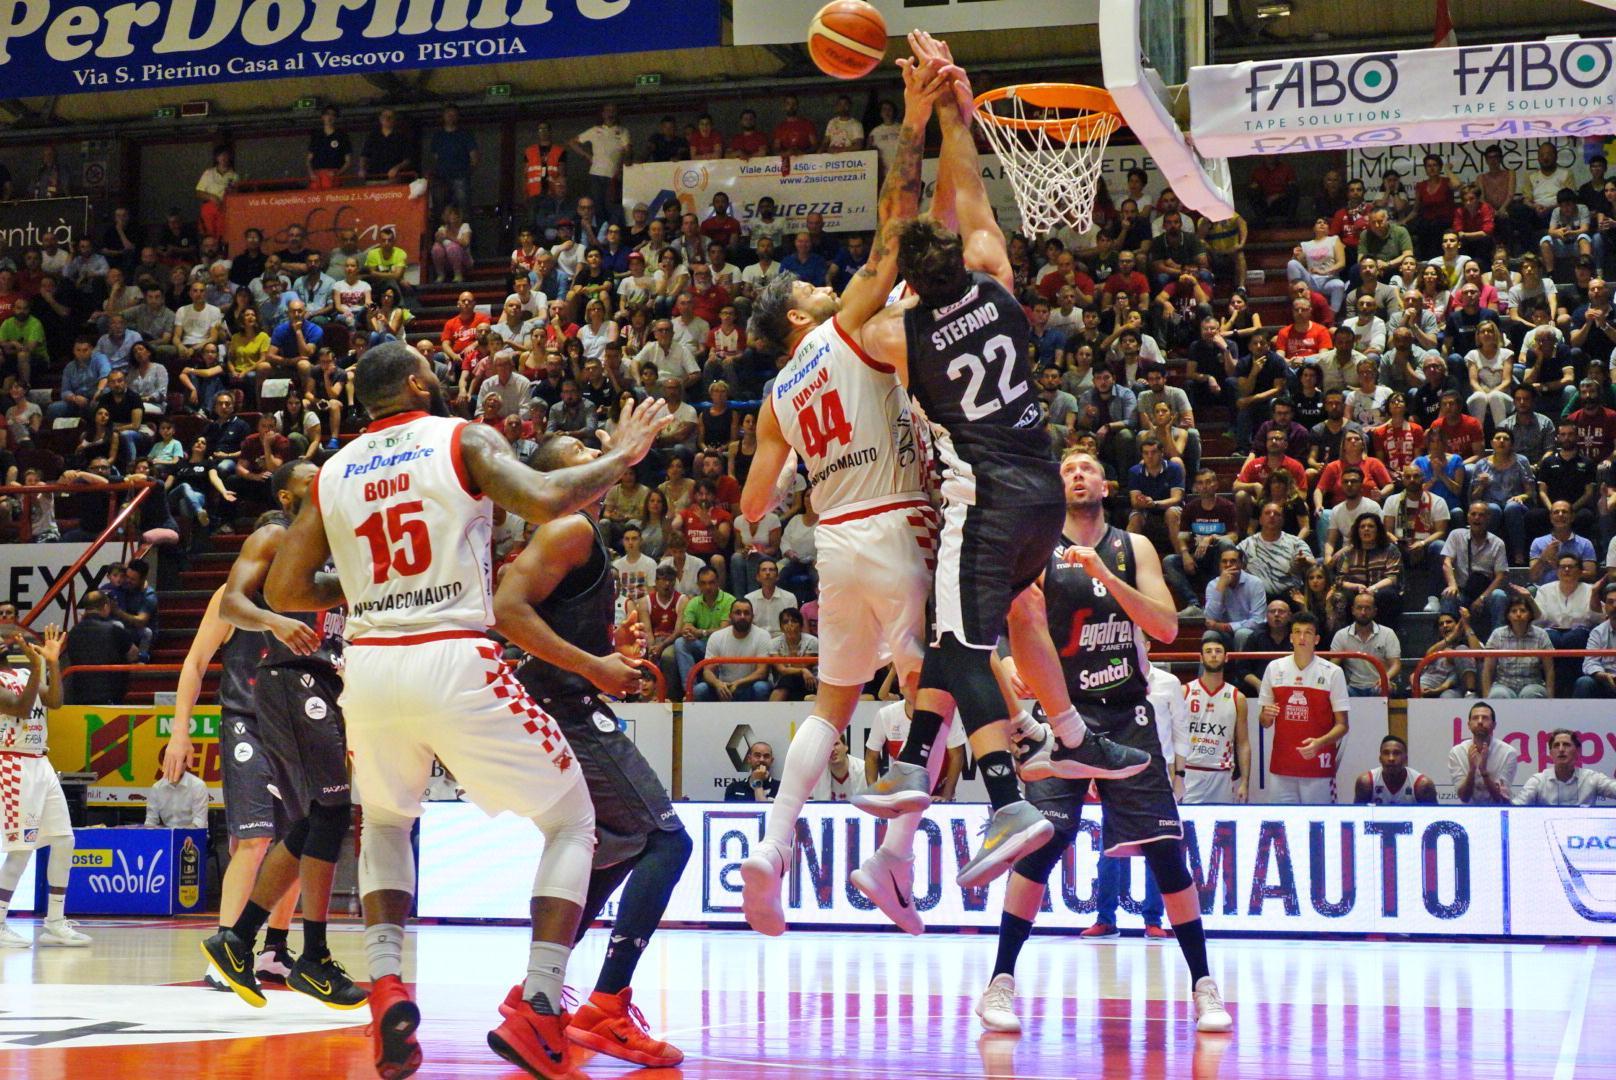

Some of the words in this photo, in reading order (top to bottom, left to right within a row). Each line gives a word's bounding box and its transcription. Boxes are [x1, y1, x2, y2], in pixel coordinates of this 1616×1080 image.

[73, 69, 108, 86] Via
[115, 66, 135, 83] S.
[141, 61, 220, 82] Pierino
[227, 56, 278, 75] Casa
[285, 52, 304, 71] al
[312, 50, 405, 68] Vescovo
[418, 36, 527, 61] PISTOIA
[1245, 53, 1398, 112] FABO
[1453, 40, 1613, 95] FABO
[1245, 118, 1287, 131] TAPE
[1298, 108, 1401, 127] SOLUTIONS
[1452, 102, 1496, 114] TAPE
[1507, 94, 1614, 111] SOLUTIONS
[740, 165, 762, 174] Viale
[765, 164, 785, 173] Adu
[780, 172, 867, 185] www.2asicurezza.it
[742, 199, 844, 219] siurezza
[931, 301, 999, 351] STEFANO
[777, 342, 830, 400] PerDormre
[946, 334, 1029, 422] 22
[798, 388, 852, 459] 44
[343, 445, 434, 479] PerDormire
[364, 473, 410, 502] BOND
[354, 500, 433, 584] 15
[1092, 577, 1107, 597] 8
[1100, 643, 1133, 652] ZANETTI
[1134, 704, 1149, 726] 8
[1190, 699, 1201, 713] 6
[1188, 721, 1227, 737] FLEXX
[1318, 752, 1332, 769] 12
[71, 853, 104, 866] oste
[88, 848, 166, 894] mobile
[787, 816, 1471, 920] NUOVCMAUTO
